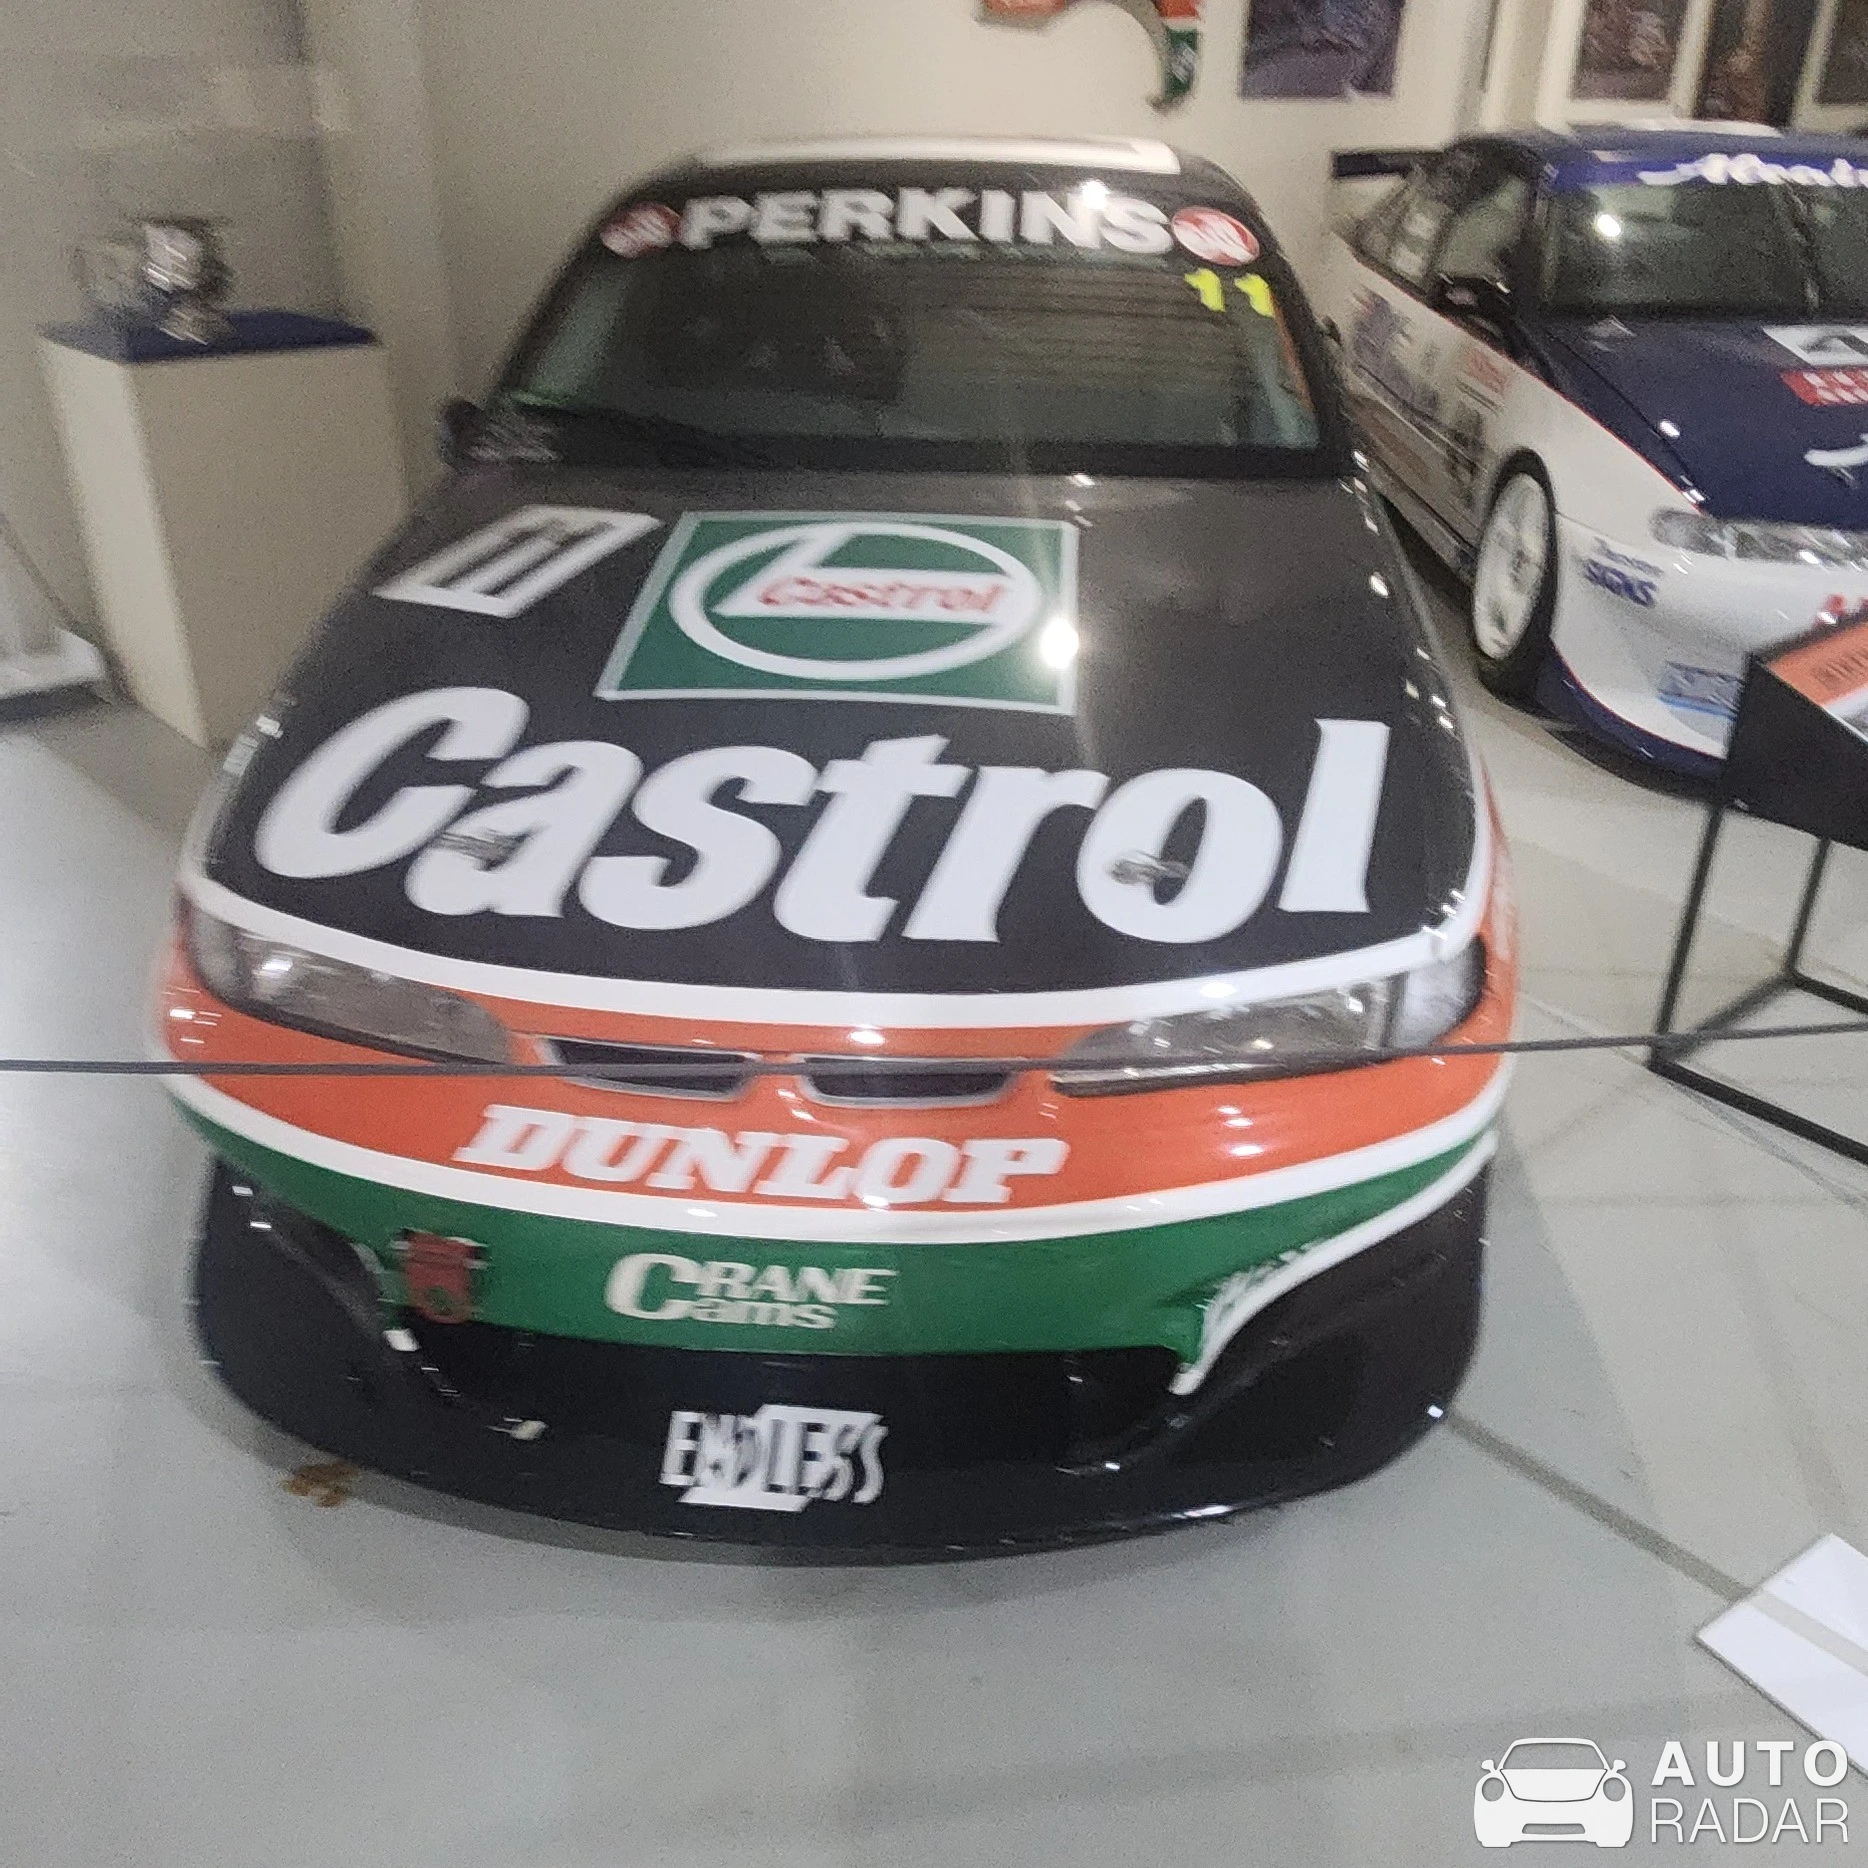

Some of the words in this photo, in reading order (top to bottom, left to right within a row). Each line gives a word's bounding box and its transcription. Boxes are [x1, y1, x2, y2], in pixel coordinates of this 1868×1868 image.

[678, 186, 1174, 255] PERKINS
[1184, 267, 1276, 319] 11
[759, 576, 1008, 613] Castrol
[254, 686, 1391, 944] Castrol
[450, 1104, 1069, 1204] DUNLOP
[605, 1252, 899, 1321] CRANE
